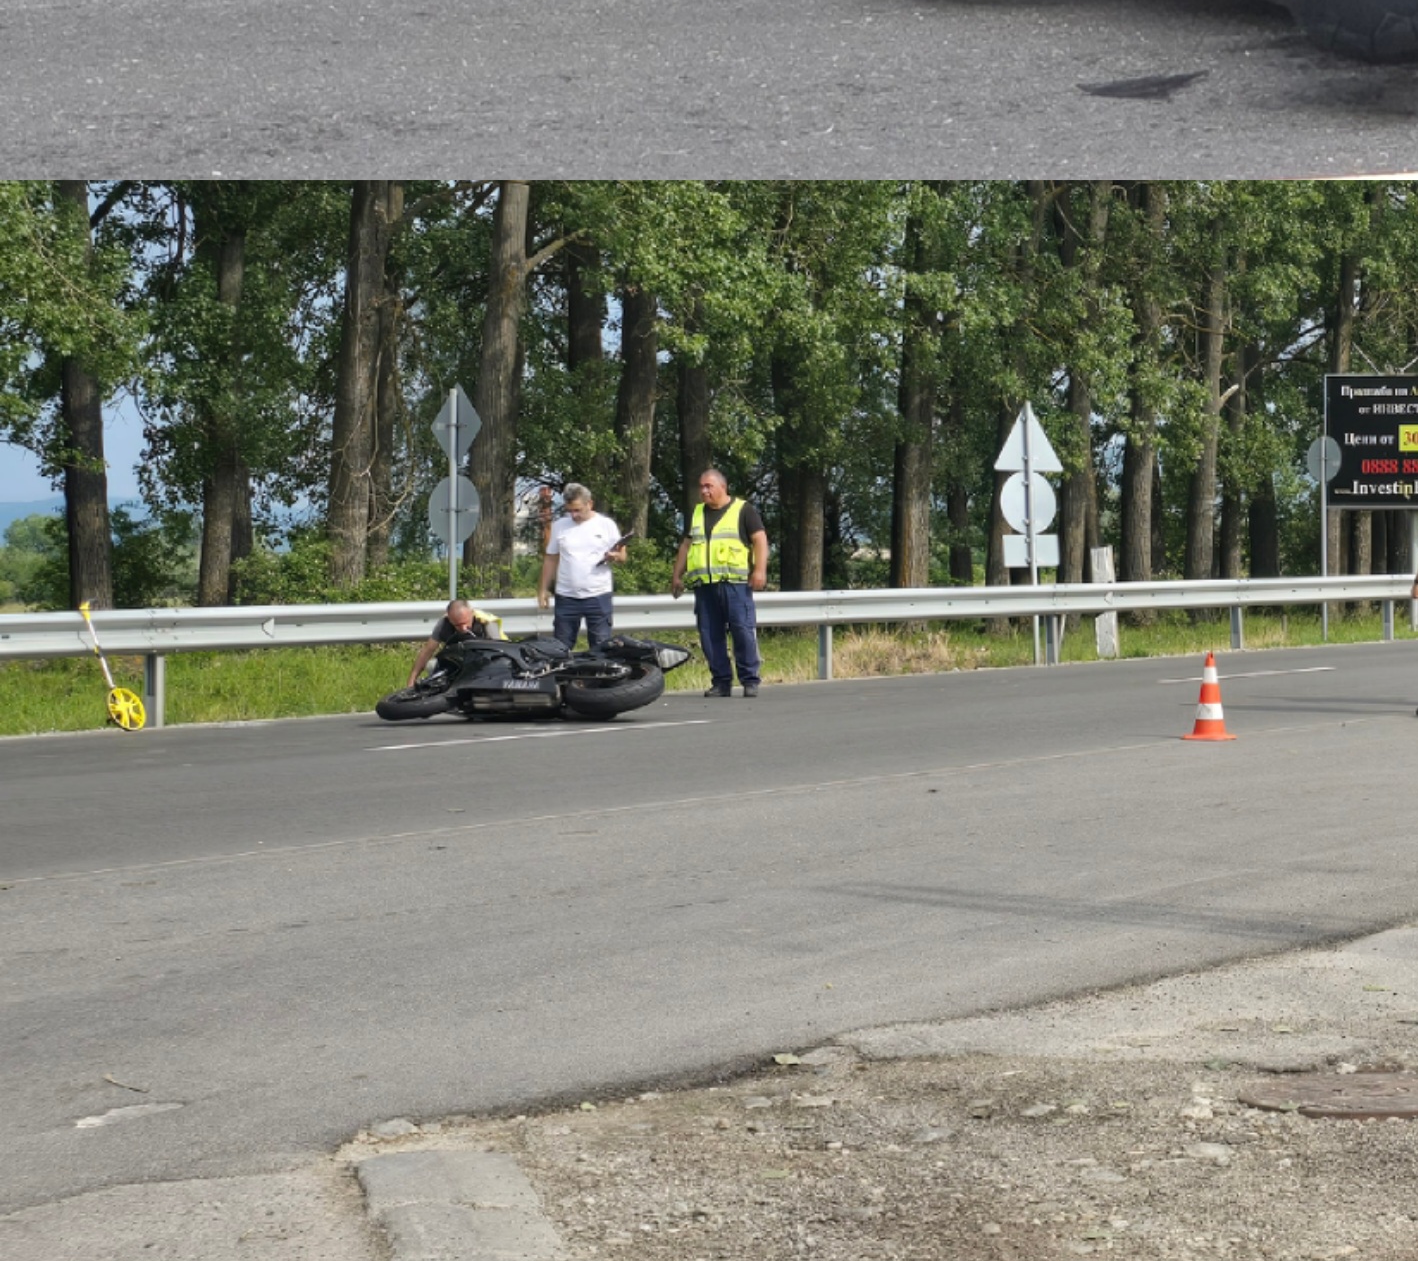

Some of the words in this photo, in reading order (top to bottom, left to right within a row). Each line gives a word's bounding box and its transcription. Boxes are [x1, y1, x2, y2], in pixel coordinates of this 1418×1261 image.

[1395, 387, 1408, 397] на
[1358, 405, 1371, 415] от
[1344, 432, 1377, 448] Цени
[1379, 434, 1395, 445] от
[1361, 459, 1398, 474] 0888
